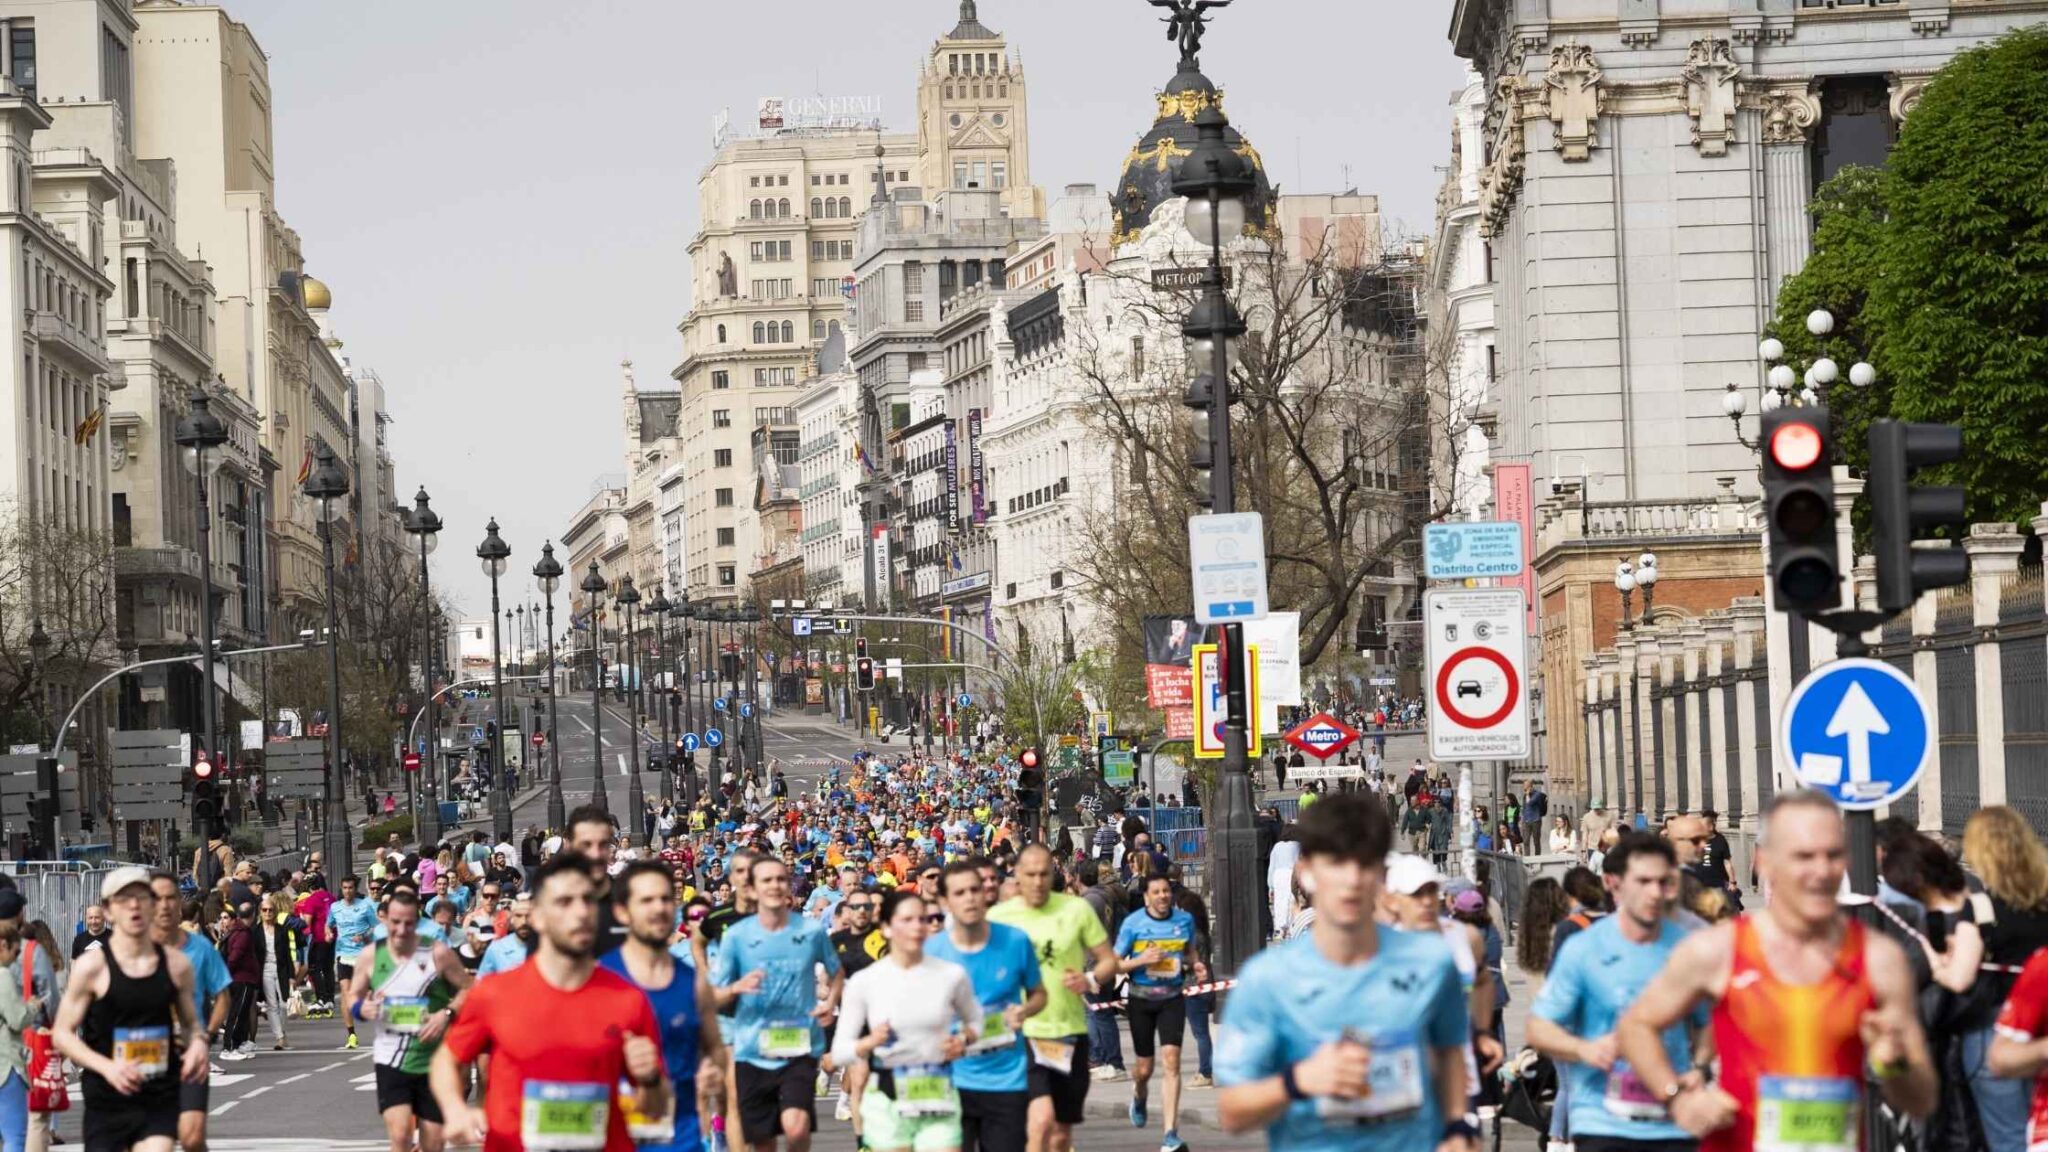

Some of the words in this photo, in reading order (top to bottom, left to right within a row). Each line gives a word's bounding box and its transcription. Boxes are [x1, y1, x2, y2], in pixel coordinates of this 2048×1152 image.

[788, 96, 881, 117] GENERALI
[1156, 271, 1210, 286] METROP
[947, 447, 956, 491] MUJERES
[949, 509, 957, 527] POR
[1432, 564, 1474, 575] Distrito
[1476, 562, 1518, 573] Centro
[1165, 676, 1190, 687] lucha
[1163, 686, 1183, 696] vida
[1306, 731, 1340, 741] Metro
[1453, 744, 1507, 752] AUTORIZADOS
[1291, 768, 1316, 776] Banco
